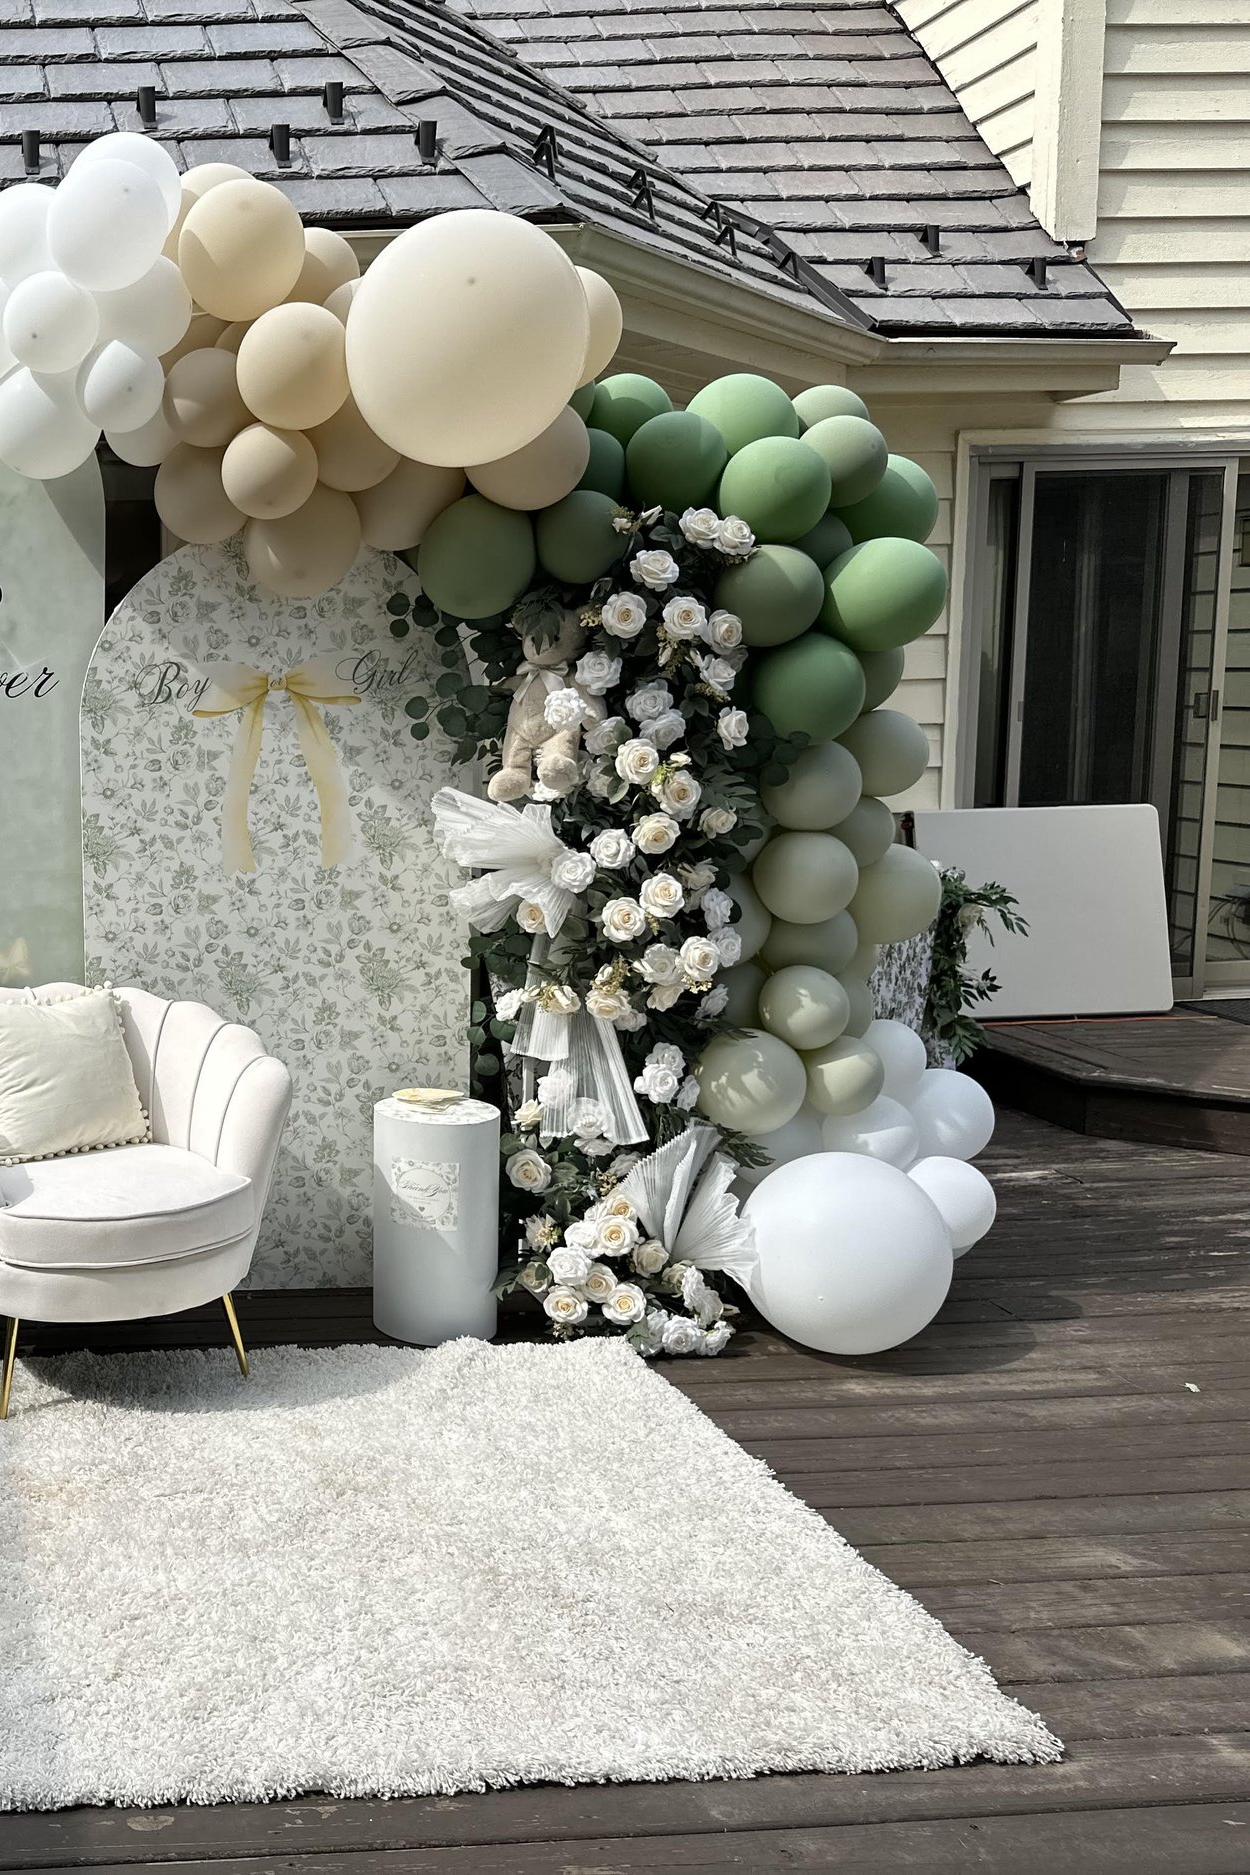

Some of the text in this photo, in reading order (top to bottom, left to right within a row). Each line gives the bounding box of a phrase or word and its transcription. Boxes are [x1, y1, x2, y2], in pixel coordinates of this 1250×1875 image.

[136, 649, 419, 713] Boy or Girl
